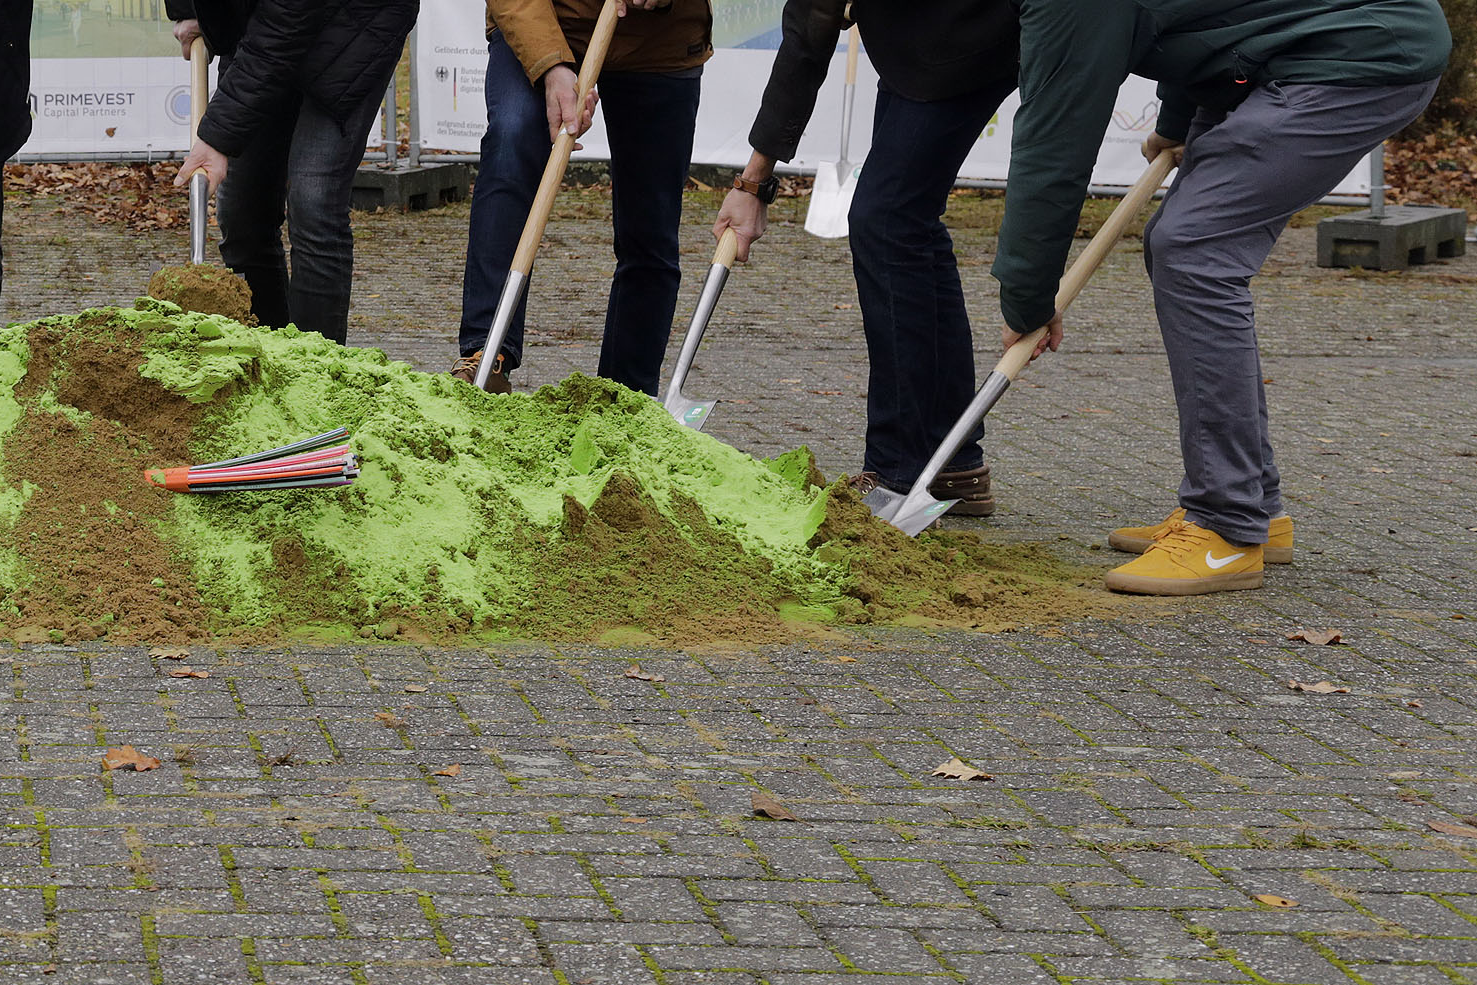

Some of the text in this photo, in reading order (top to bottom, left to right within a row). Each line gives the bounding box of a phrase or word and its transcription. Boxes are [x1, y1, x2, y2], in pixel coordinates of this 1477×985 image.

[434, 46, 469, 55] Gefördert
[44, 92, 135, 106] PRIMEVEST
[43, 106, 127, 119] Capital Partners
